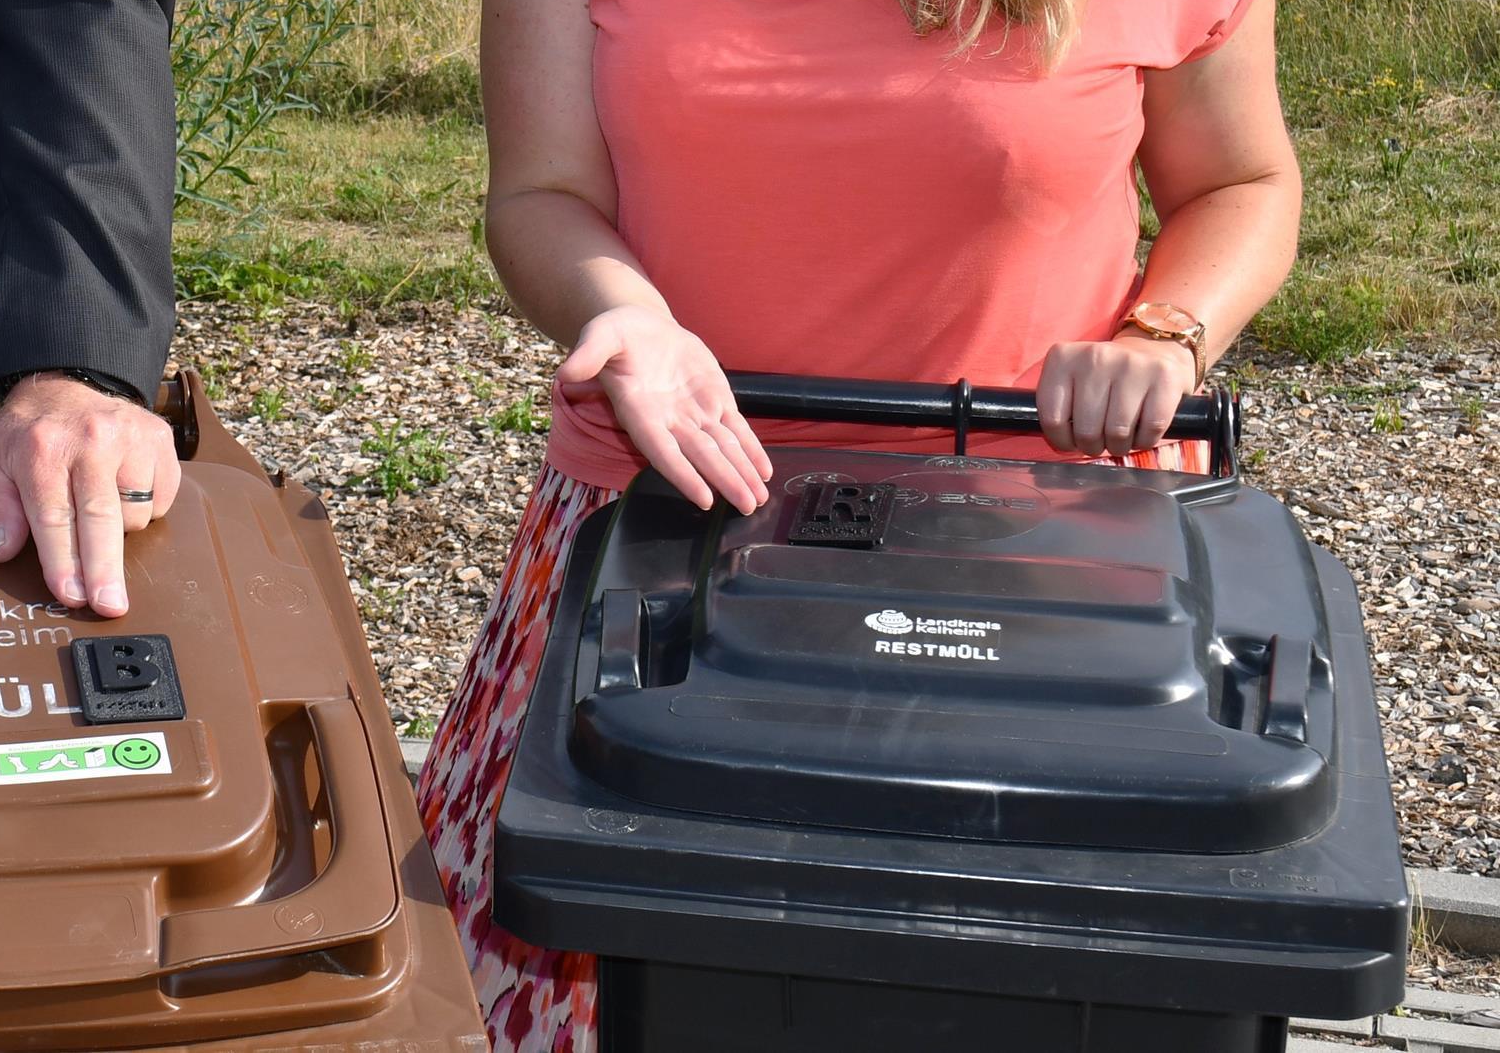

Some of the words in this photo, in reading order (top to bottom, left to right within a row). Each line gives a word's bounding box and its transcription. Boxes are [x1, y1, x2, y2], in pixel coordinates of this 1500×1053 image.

[916, 617, 1001, 630] Landkreis
[916, 624, 986, 637] Kelheim
[875, 640, 1000, 661] RESTMÜLL
[92, 636, 160, 693] B
